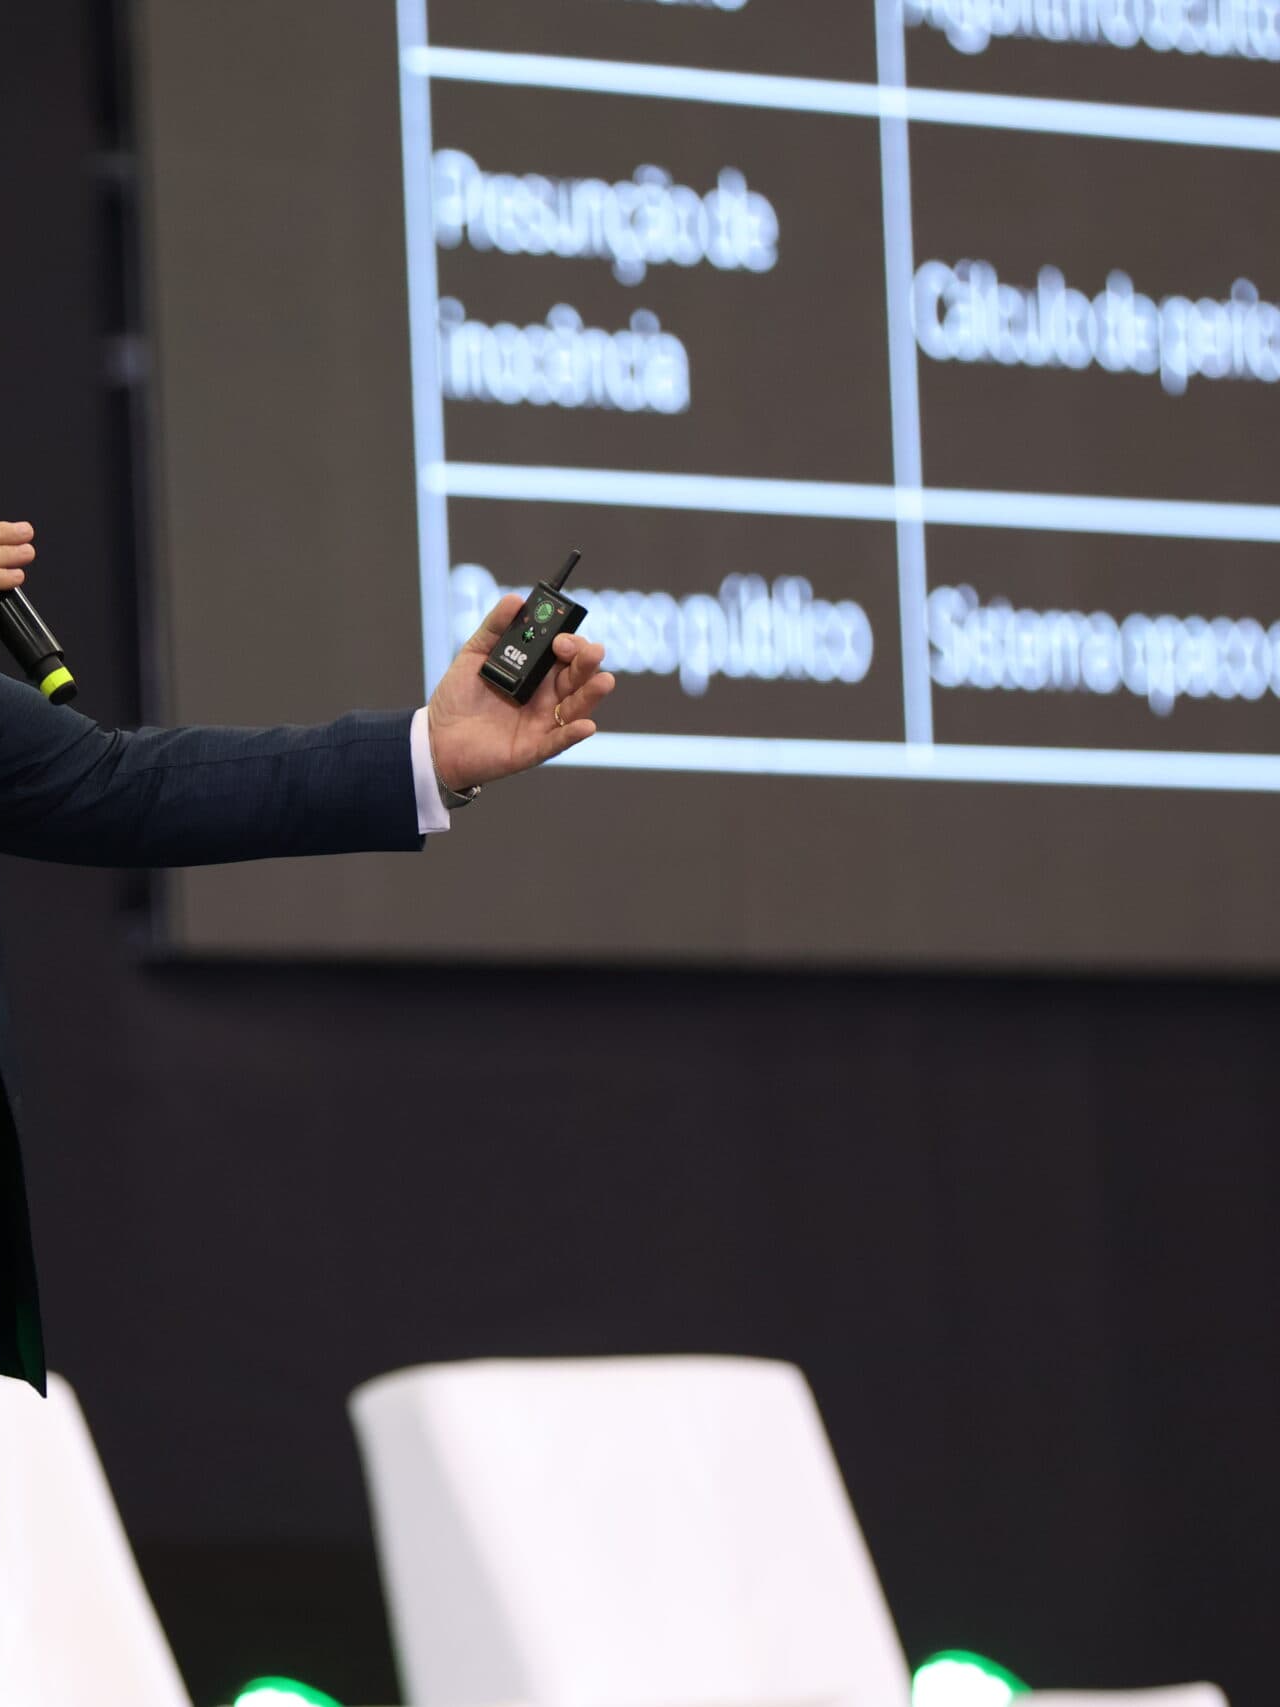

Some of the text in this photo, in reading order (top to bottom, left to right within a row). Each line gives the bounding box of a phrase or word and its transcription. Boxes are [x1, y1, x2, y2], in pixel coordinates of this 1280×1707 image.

[432, 148, 779, 286] Presunção de
[437, 296, 690, 414] inocência
[912, 259, 1093, 371] Cálculo
[1092, 268, 1160, 376] de
[504, 644, 527, 666] cue
[679, 572, 873, 697] público
[924, 583, 1120, 694] Sistema
